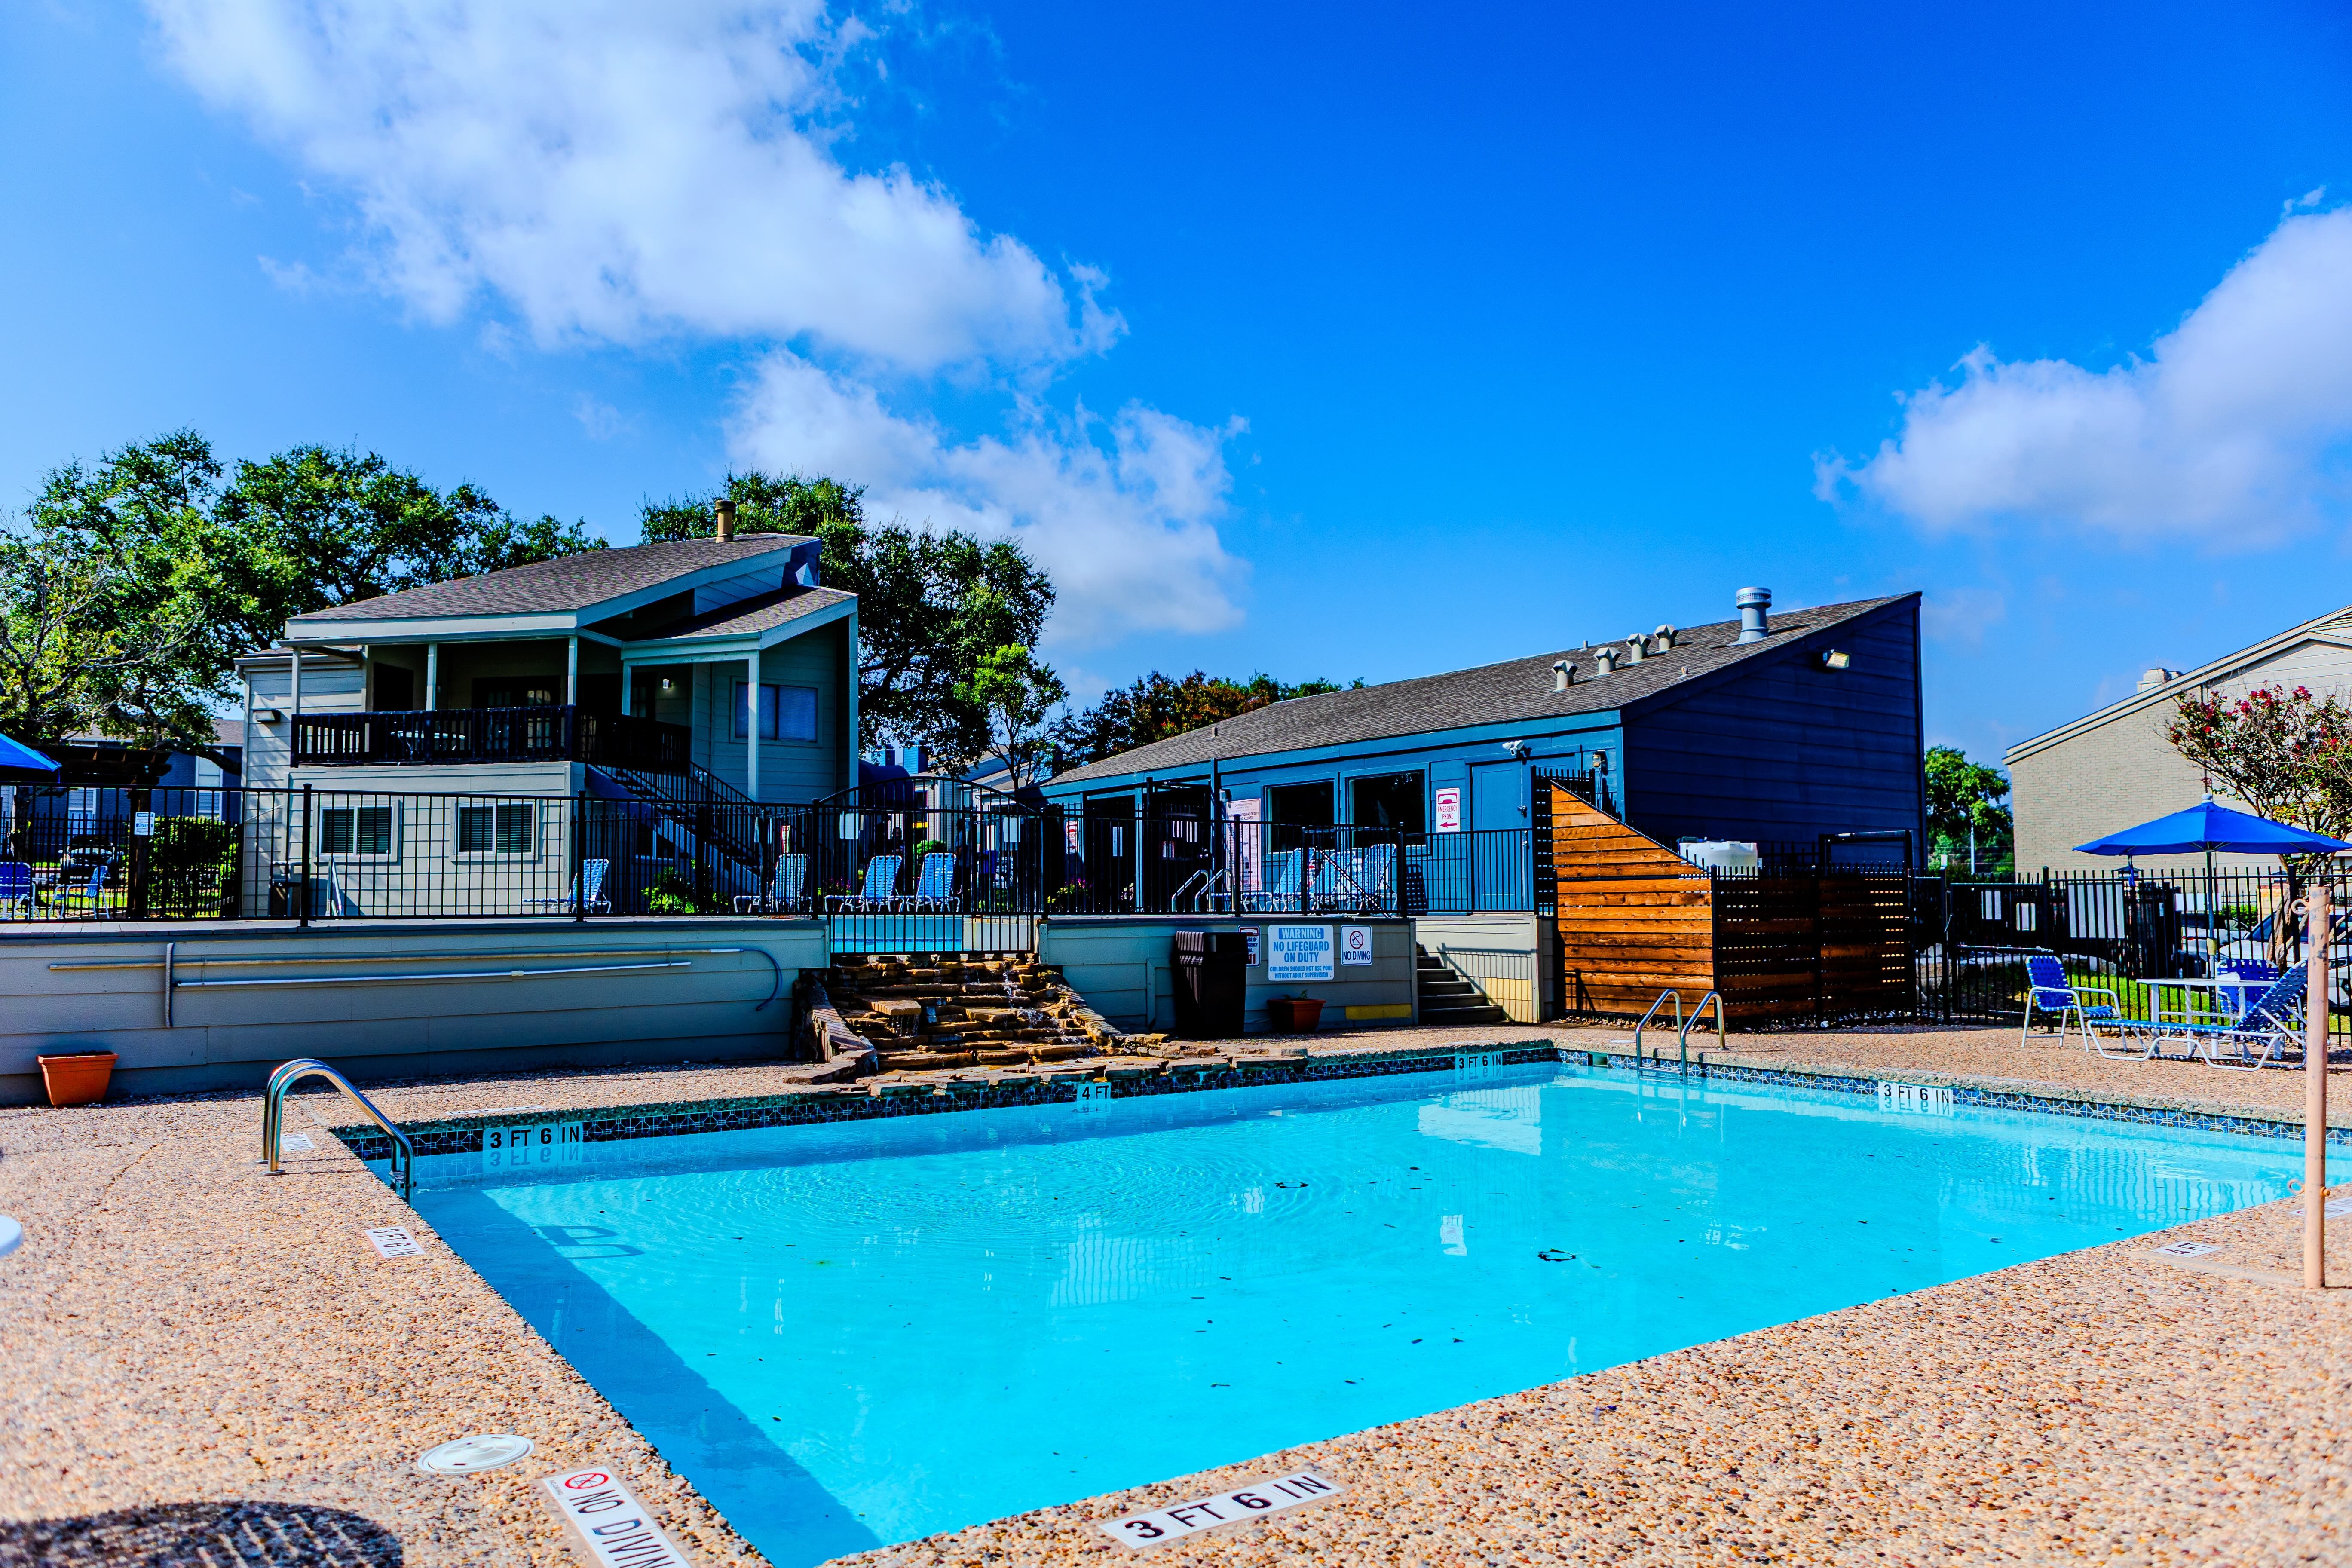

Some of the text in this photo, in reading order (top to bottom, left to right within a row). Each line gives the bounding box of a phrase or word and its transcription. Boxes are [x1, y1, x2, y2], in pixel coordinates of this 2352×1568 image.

[1282, 928, 1321, 939] WARNING
[1274, 941, 1329, 951] NO LIFEGUARD
[1284, 952, 1319, 962] ON DUTY
[1343, 951, 1370, 960] NO DIVING
[1459, 1054, 1501, 1069] 3 FT 6 IN
[1082, 1085, 1109, 1100] 4 FT
[1884, 1084, 1949, 1103] 3 FT 6 IN
[490, 1126, 579, 1149] 3 FT 6 IN
[387, 1248, 420, 1256] IN
[2175, 1242, 2214, 1251] FT
[1124, 1476, 1333, 1538] 3 FT 6 IN
[569, 1489, 676, 1568] NO DIVIN
